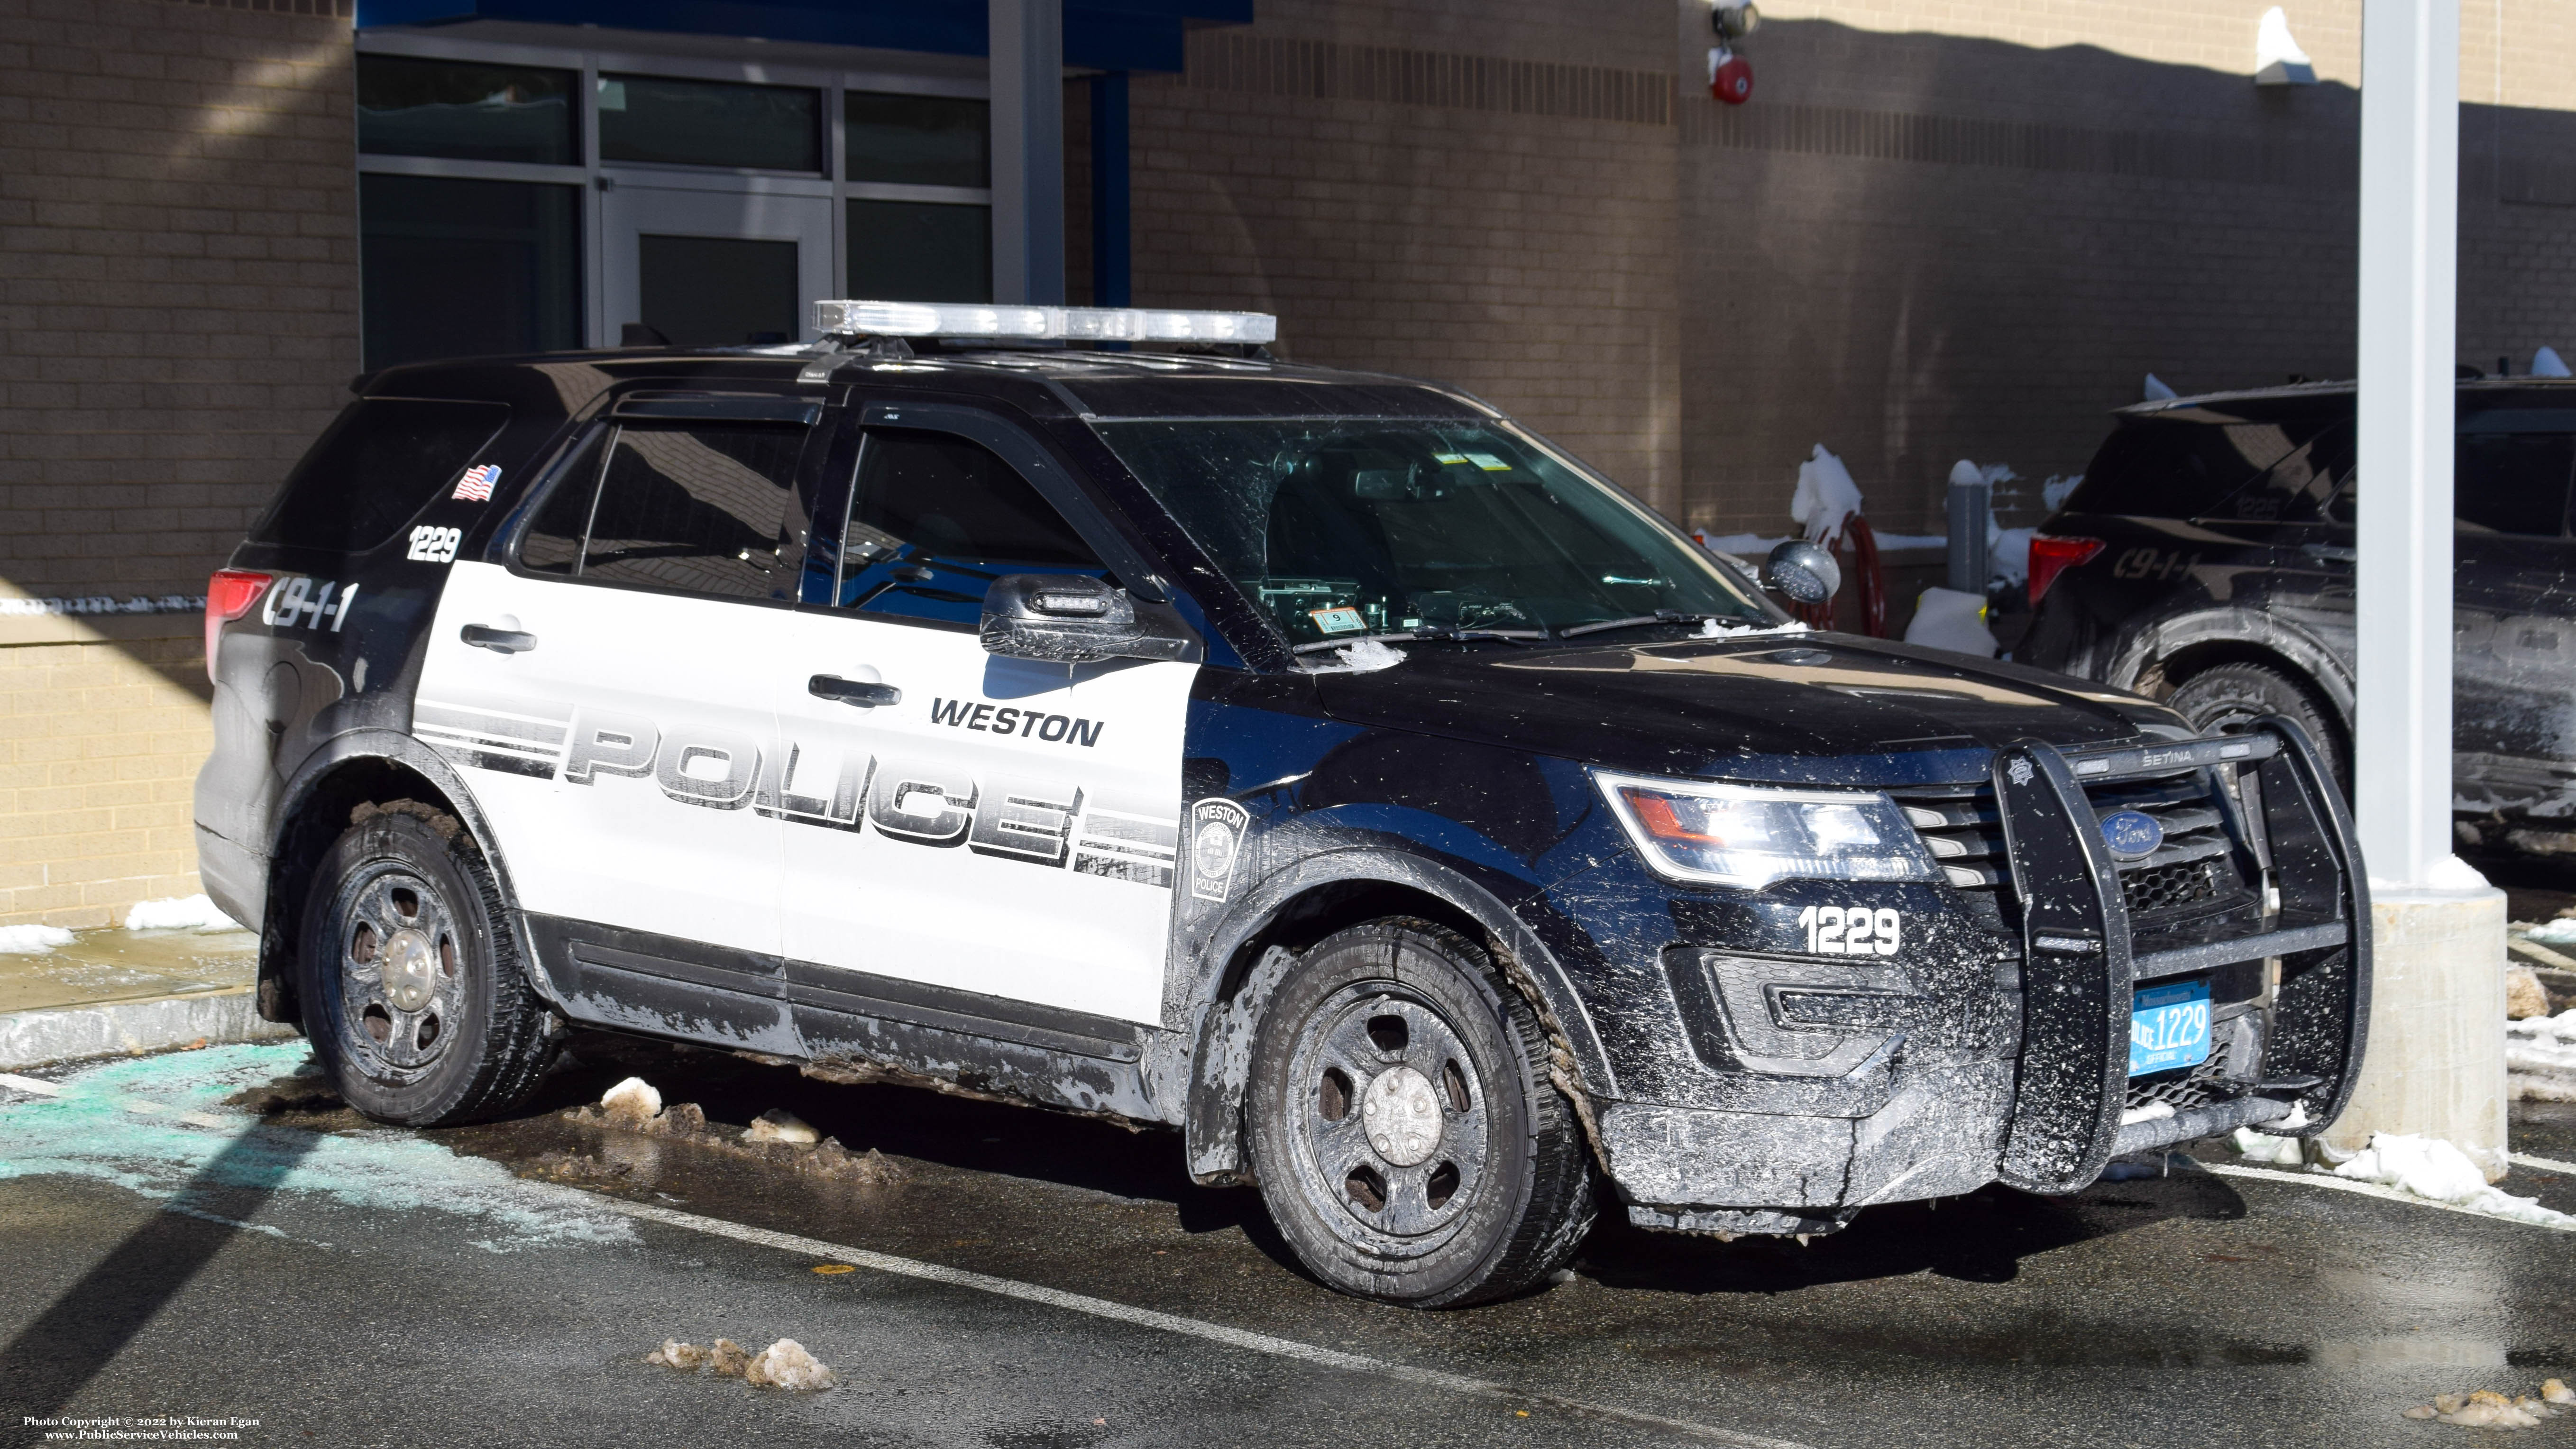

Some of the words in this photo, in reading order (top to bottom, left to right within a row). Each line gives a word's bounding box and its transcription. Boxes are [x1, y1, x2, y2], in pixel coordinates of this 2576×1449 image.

[407, 525, 462, 563] 1229
[931, 697, 1105, 748] WESTON
[2142, 751, 2192, 767] SETINA
[563, 705, 1084, 870] POLICE
[1198, 805, 1244, 829] WESTON
[1201, 823, 1232, 843] MASSACHUSETTS
[2115, 817, 2152, 845] Ford
[1195, 878, 1224, 893] POLICE
[1797, 906, 1900, 955] 1229
[2131, 1020, 2154, 1051] OLICE
[2154, 1004, 2207, 1051] 1229
